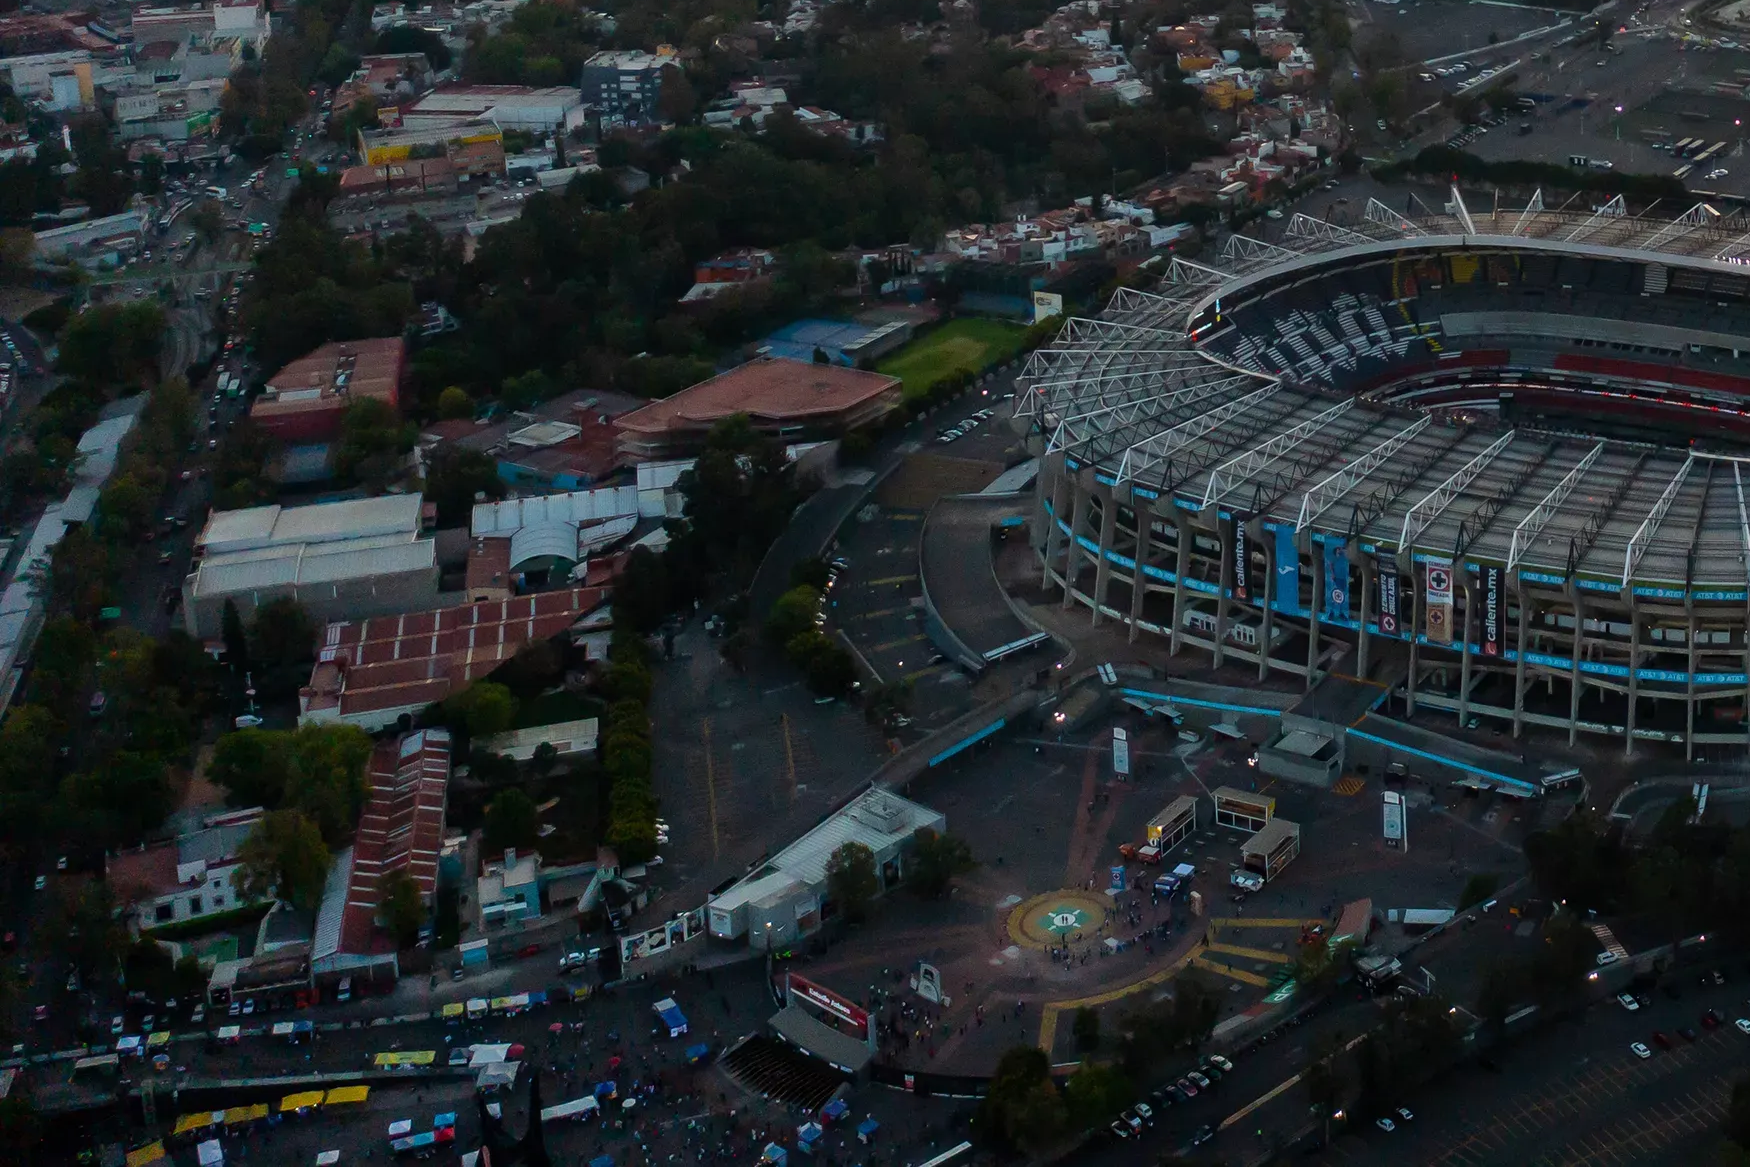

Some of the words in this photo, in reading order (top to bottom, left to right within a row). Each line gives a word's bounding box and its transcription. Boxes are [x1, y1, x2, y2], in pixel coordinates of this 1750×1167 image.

[1235, 520, 1245, 587] caliente.mx
[1380, 574, 1388, 613] CEMENTO
[1488, 568, 1498, 641] caliente.mx
[1696, 592, 1713, 600] AT&T
[1725, 592, 1743, 600] AT&T
